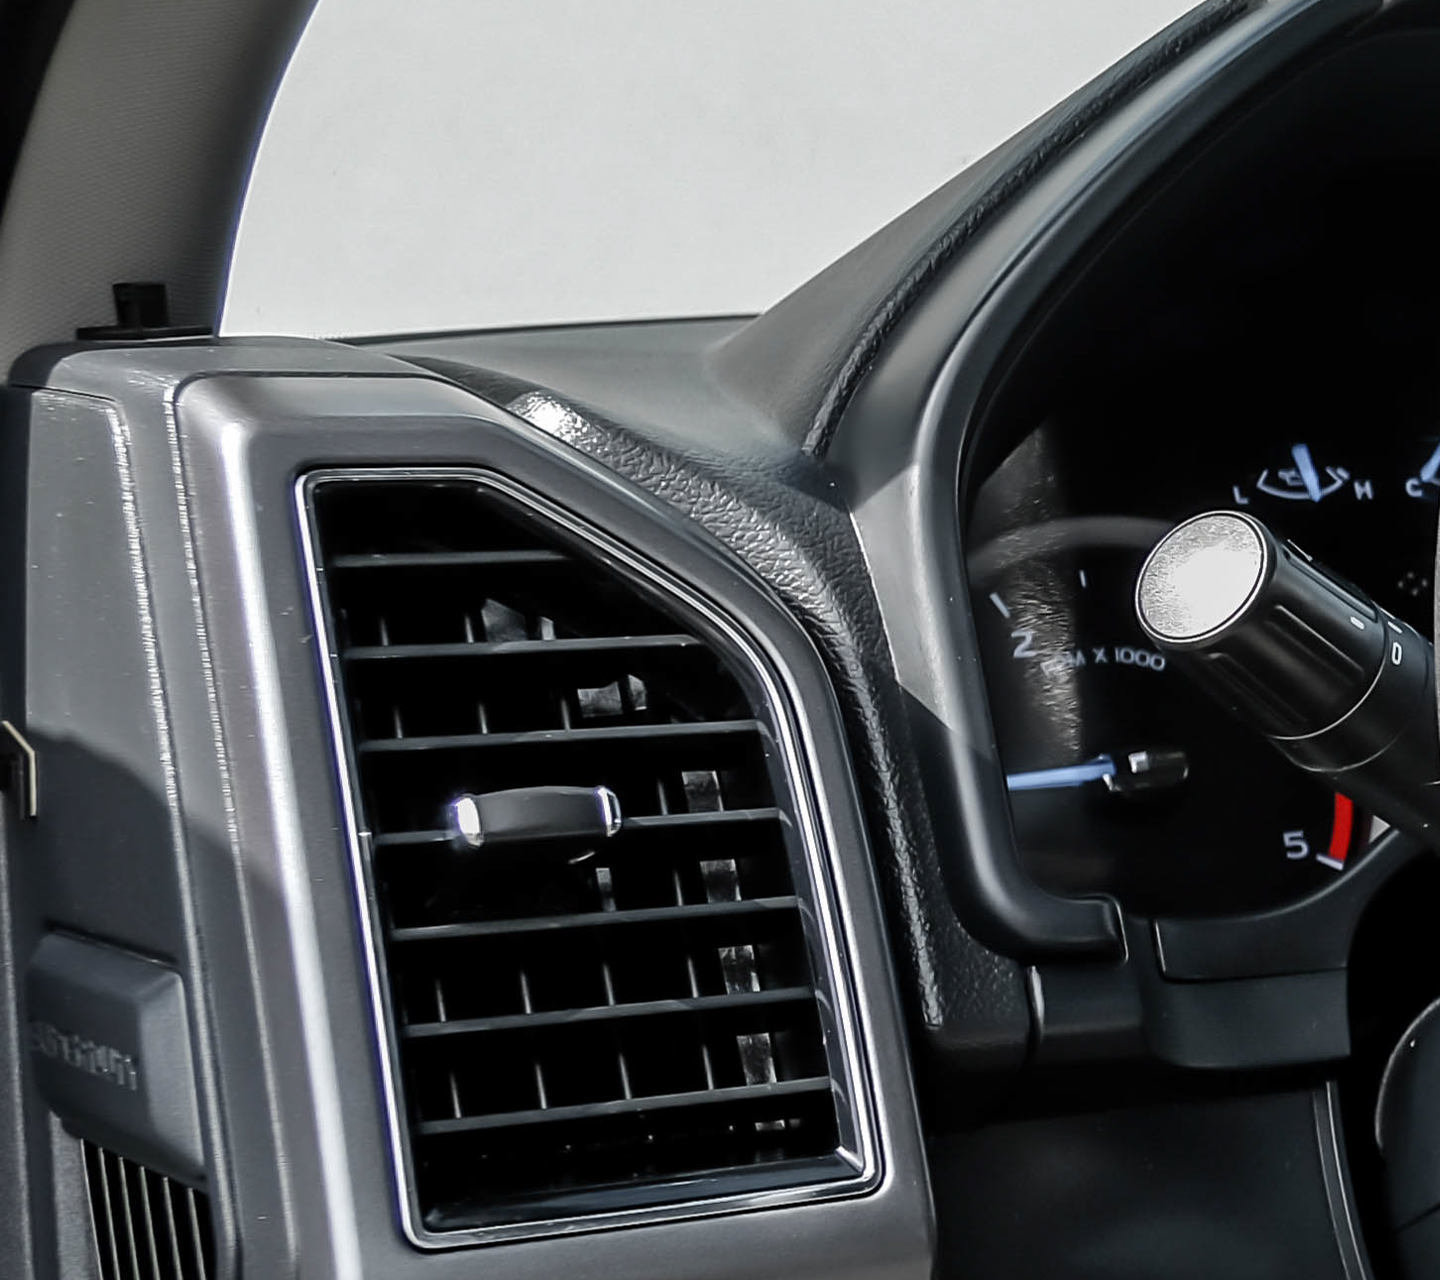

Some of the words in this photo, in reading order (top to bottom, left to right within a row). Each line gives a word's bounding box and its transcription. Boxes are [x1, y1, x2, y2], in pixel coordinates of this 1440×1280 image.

[1232, 485, 1249, 504] L
[1354, 481, 1373, 500] H
[1405, 477, 1424, 497] C
[1011, 629, 1038, 658] 2
[1115, 647, 1165, 671] 1000
[1282, 830, 1309, 859] 5
